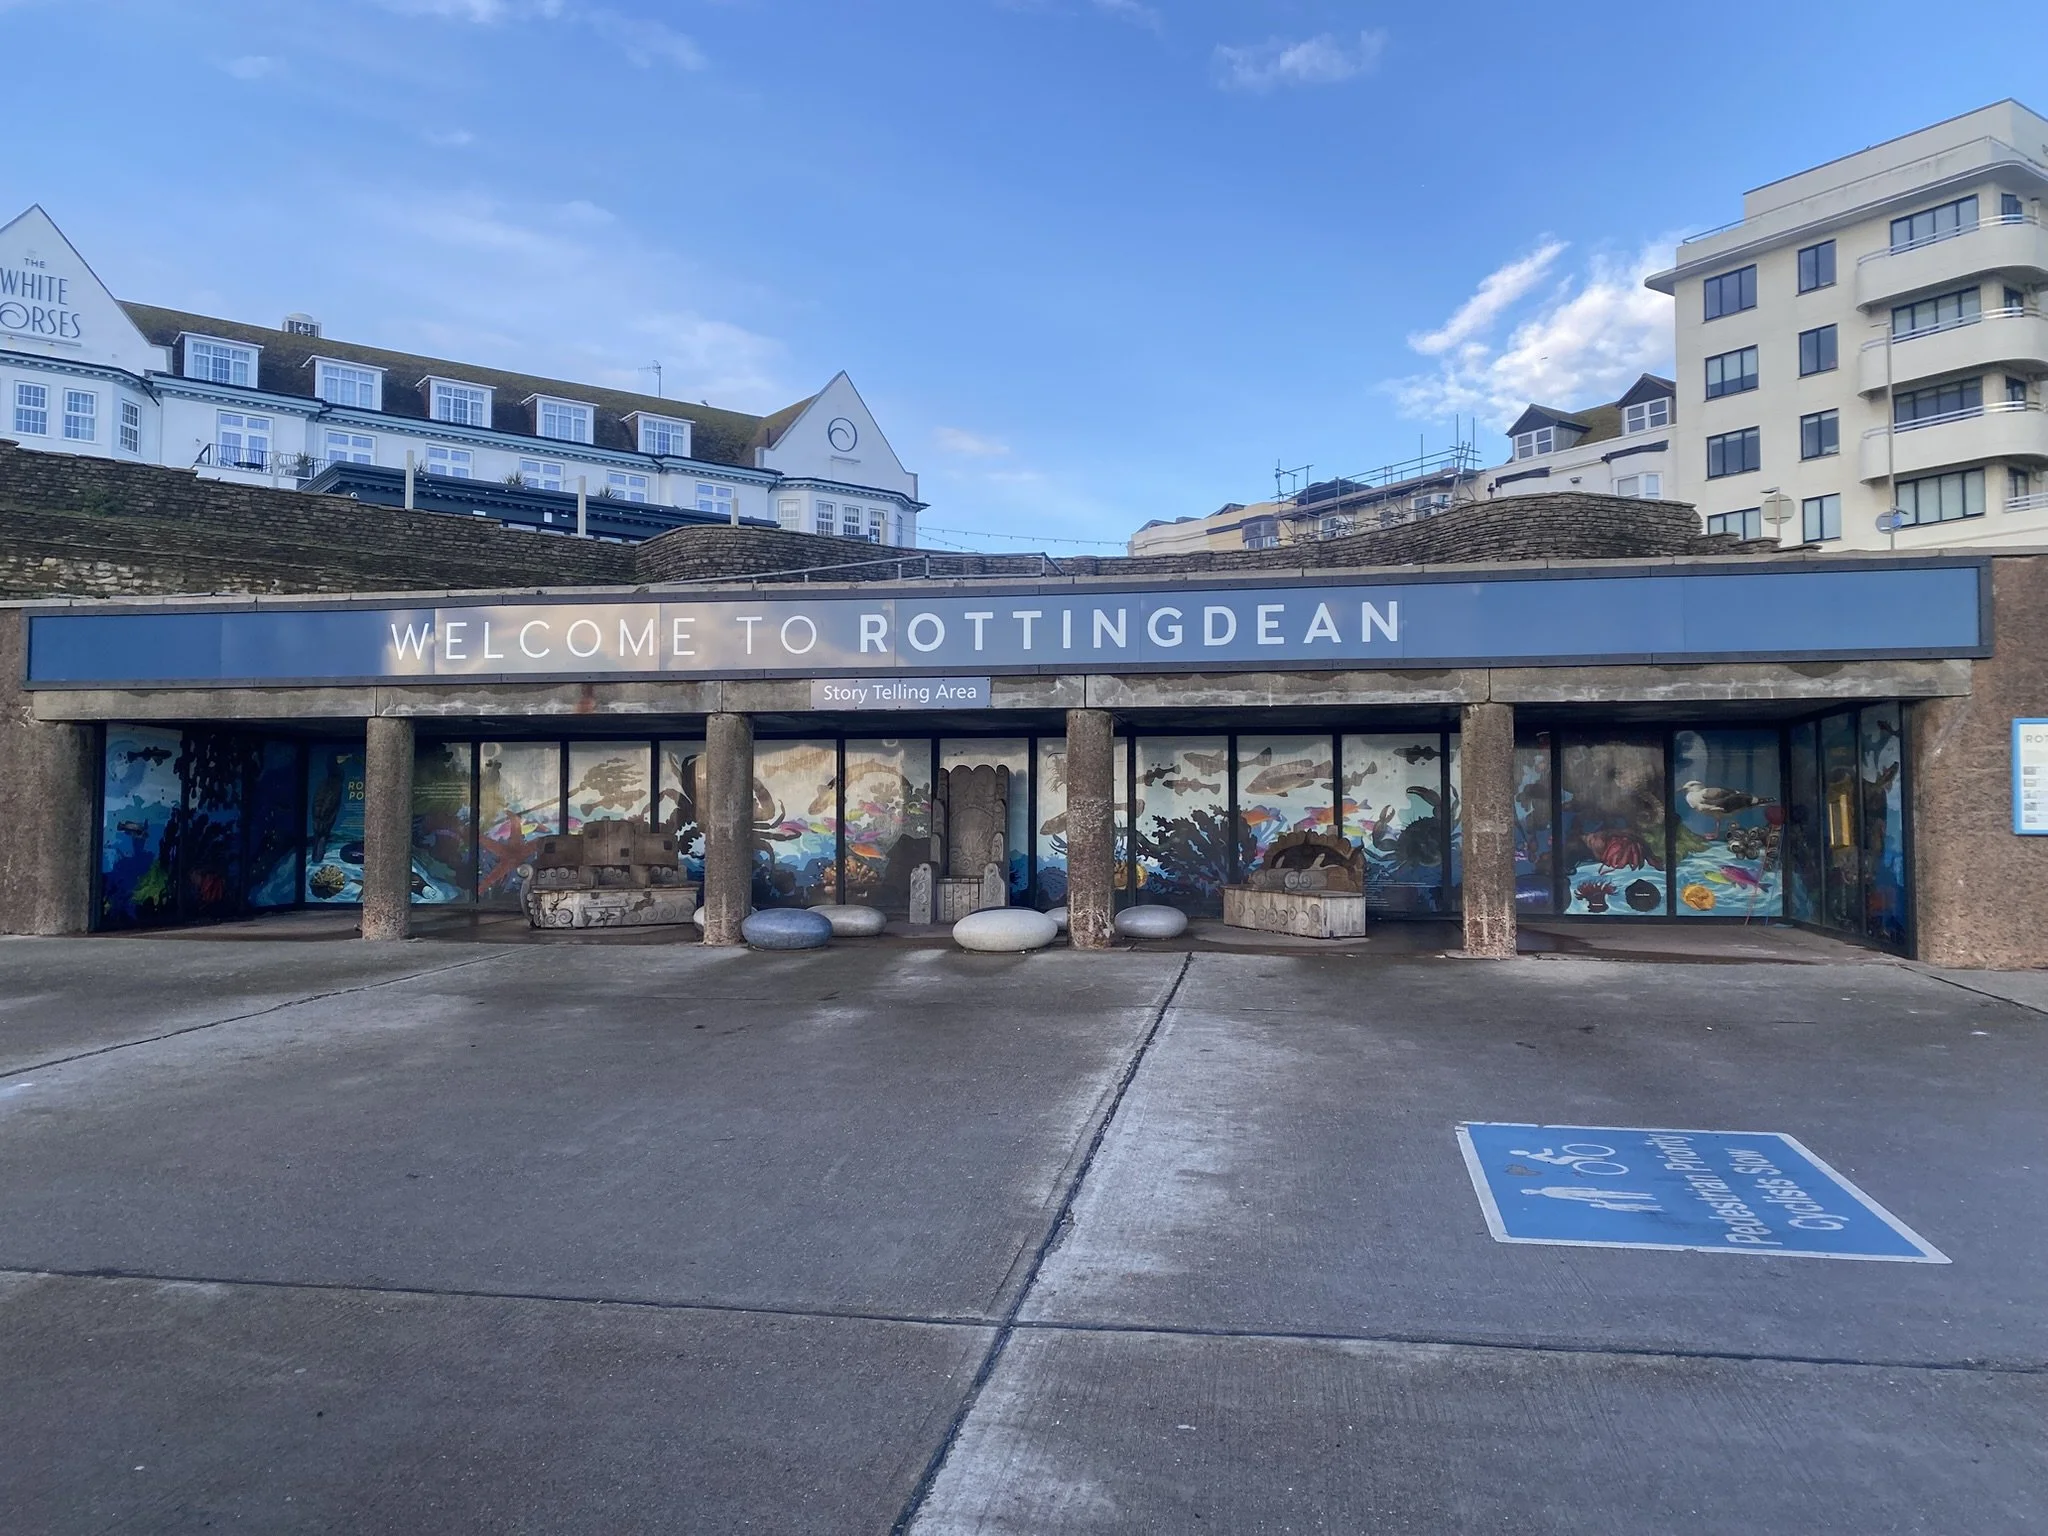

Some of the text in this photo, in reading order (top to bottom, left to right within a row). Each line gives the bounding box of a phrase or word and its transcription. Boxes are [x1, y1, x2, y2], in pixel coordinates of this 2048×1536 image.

[24, 257, 46, 269] THE
[0, 267, 69, 306] WHITE
[0, 301, 81, 339] ORSES
[390, 600, 1399, 661] WELCOME TO ROTTINGDEAN
[823, 684, 977, 704] Story Telling Area
[1644, 1133, 1784, 1246] Pedestrian Priority
[1723, 1147, 1850, 1232] Cyclists Slow
